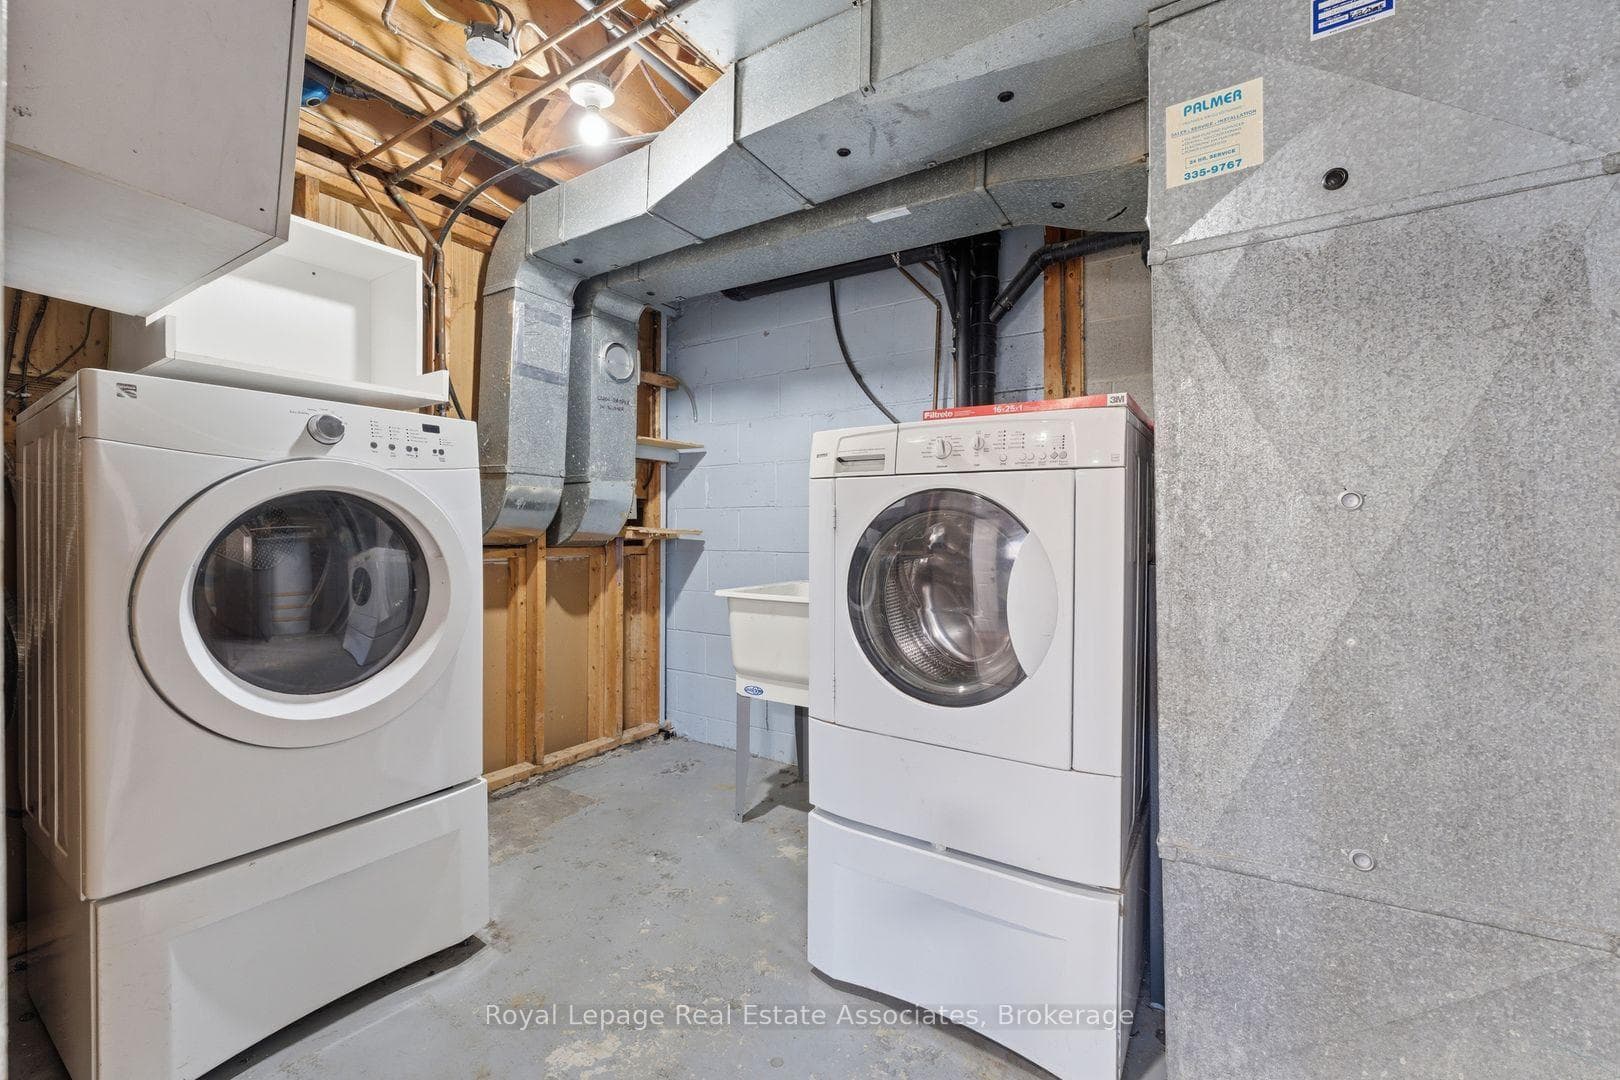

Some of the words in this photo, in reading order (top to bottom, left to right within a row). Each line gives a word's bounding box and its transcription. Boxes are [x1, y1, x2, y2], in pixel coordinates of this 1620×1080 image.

[1183, 89, 1243, 117] PALMER
[1209, 148, 1236, 159] SERVICE
[1184, 158, 1243, 181] 335-9767
[1109, 395, 1125, 404] 3M
